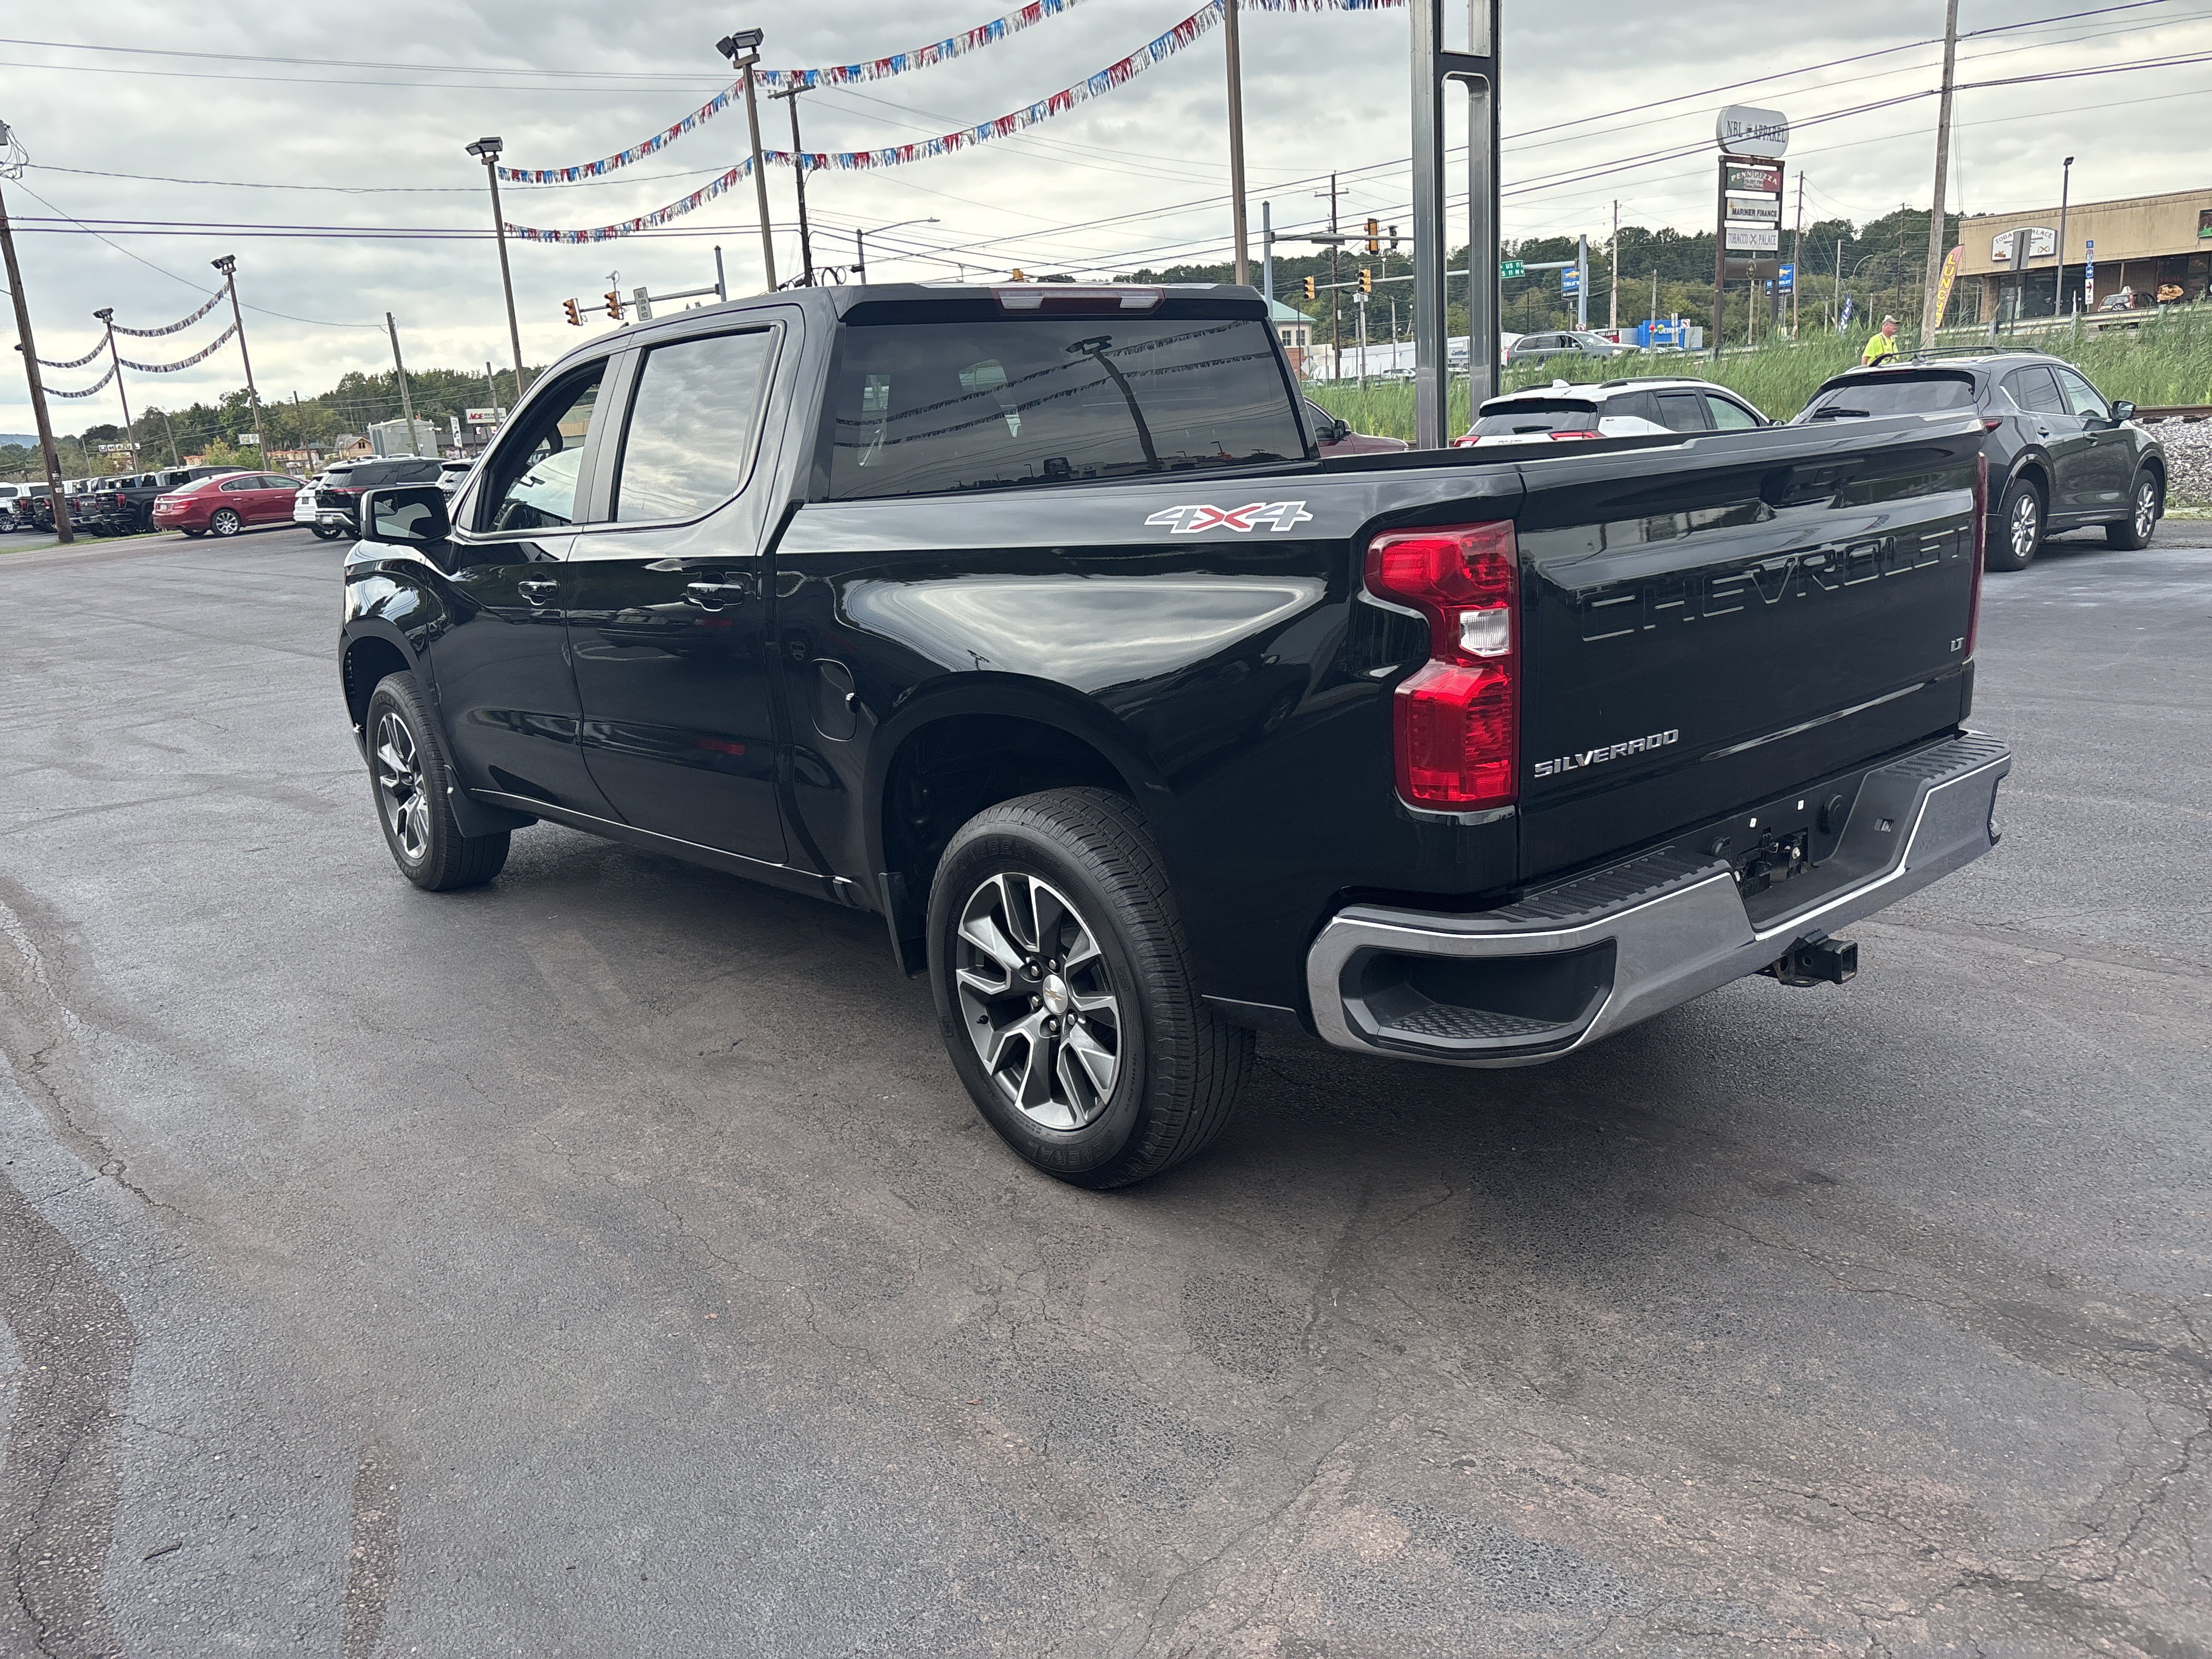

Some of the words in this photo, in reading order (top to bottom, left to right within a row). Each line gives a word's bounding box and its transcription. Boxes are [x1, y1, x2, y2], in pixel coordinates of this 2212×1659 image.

[1726, 120, 1743, 138] NBL
[1754, 123, 1786, 143] APPAREL
[1731, 171, 1752, 182] PENN
[1754, 171, 1778, 185] PIZZA
[1732, 208, 1756, 217] MARINER
[1757, 209, 1778, 217] FINANCE
[1728, 233, 1748, 245] TOBACCO
[1758, 234, 1777, 246] PALACE
[1995, 233, 2013, 244] TOBA
[2032, 228, 2053, 239] ALACE
[2087, 253, 2094, 263] 80
[1582, 525, 1970, 642] CHEVROLET
[1950, 637, 1965, 652] LT
[1534, 729, 1679, 778] SILVERADO
[1027, 1129, 1117, 1166] GENERAL
